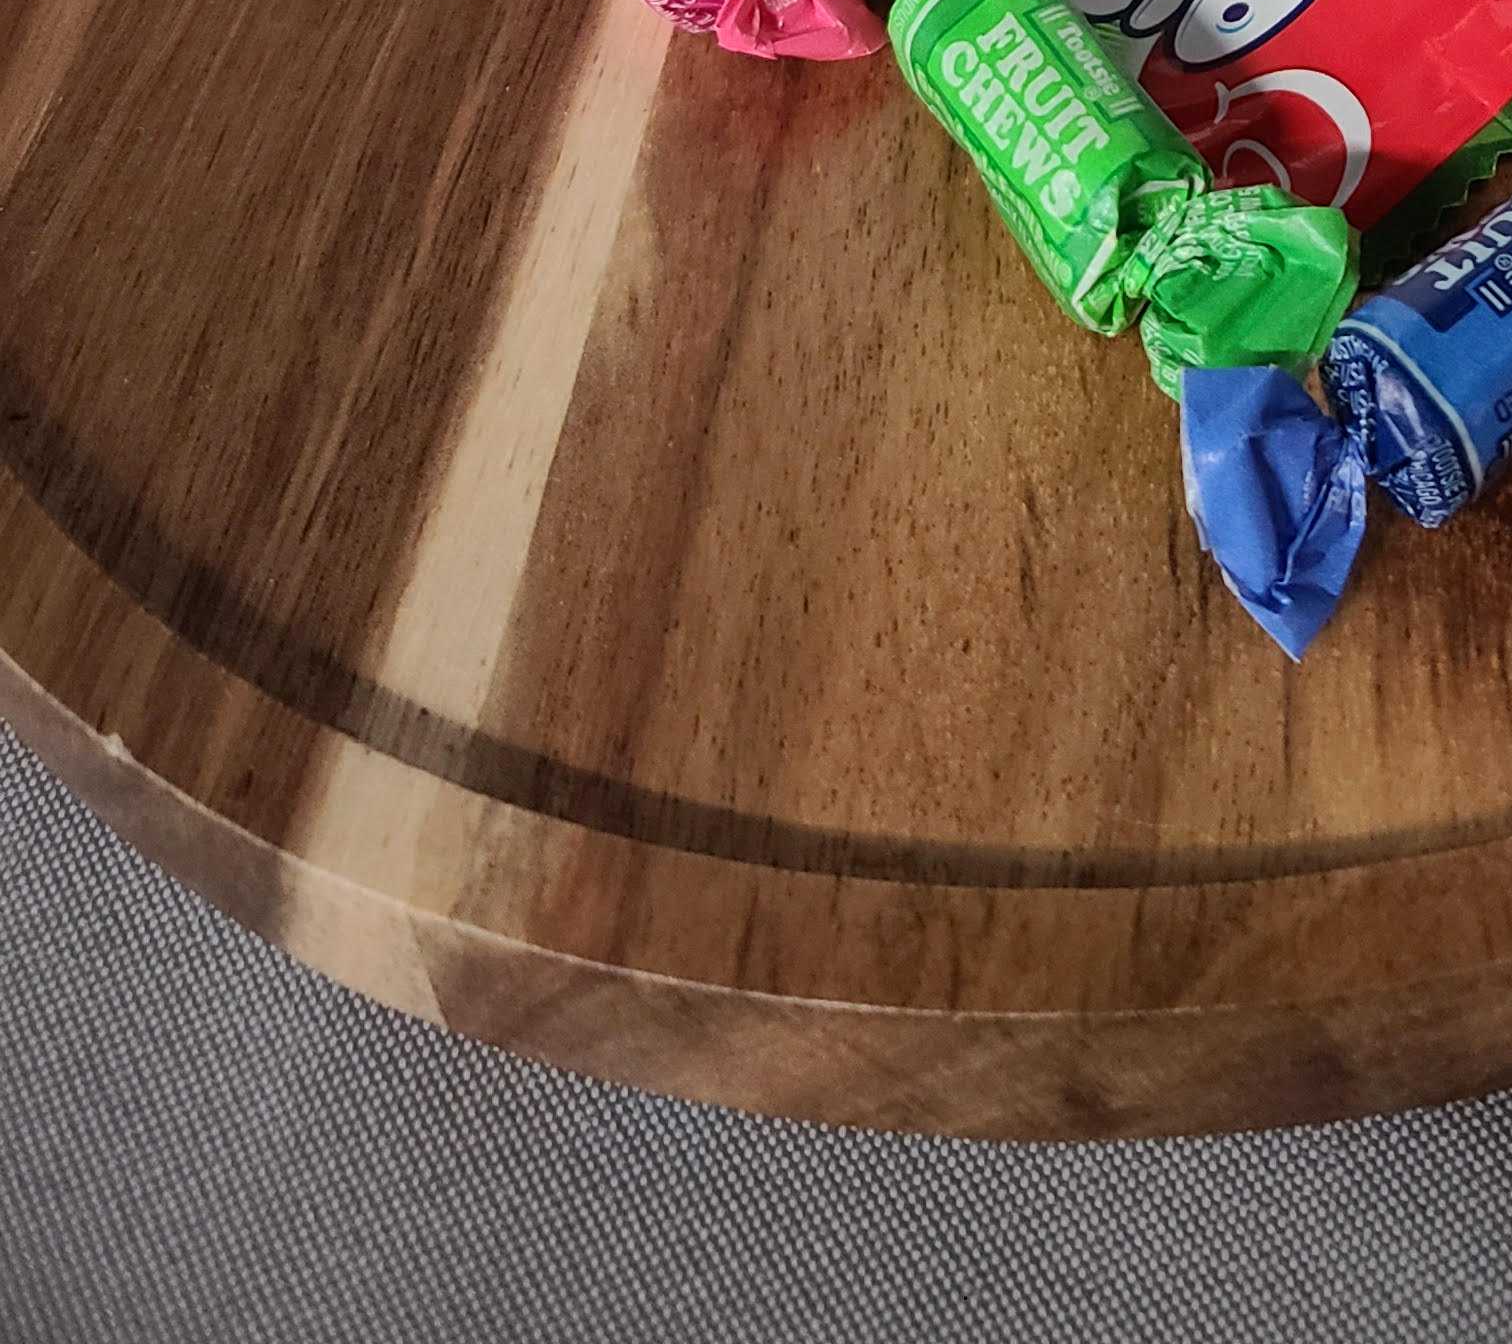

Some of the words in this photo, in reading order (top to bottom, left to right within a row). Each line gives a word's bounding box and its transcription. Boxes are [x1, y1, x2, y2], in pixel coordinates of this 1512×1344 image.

[941, 40, 1082, 219] CHEWS
[975, 10, 1111, 165] FRUIT
[1056, 21, 1121, 97] Tootsie
